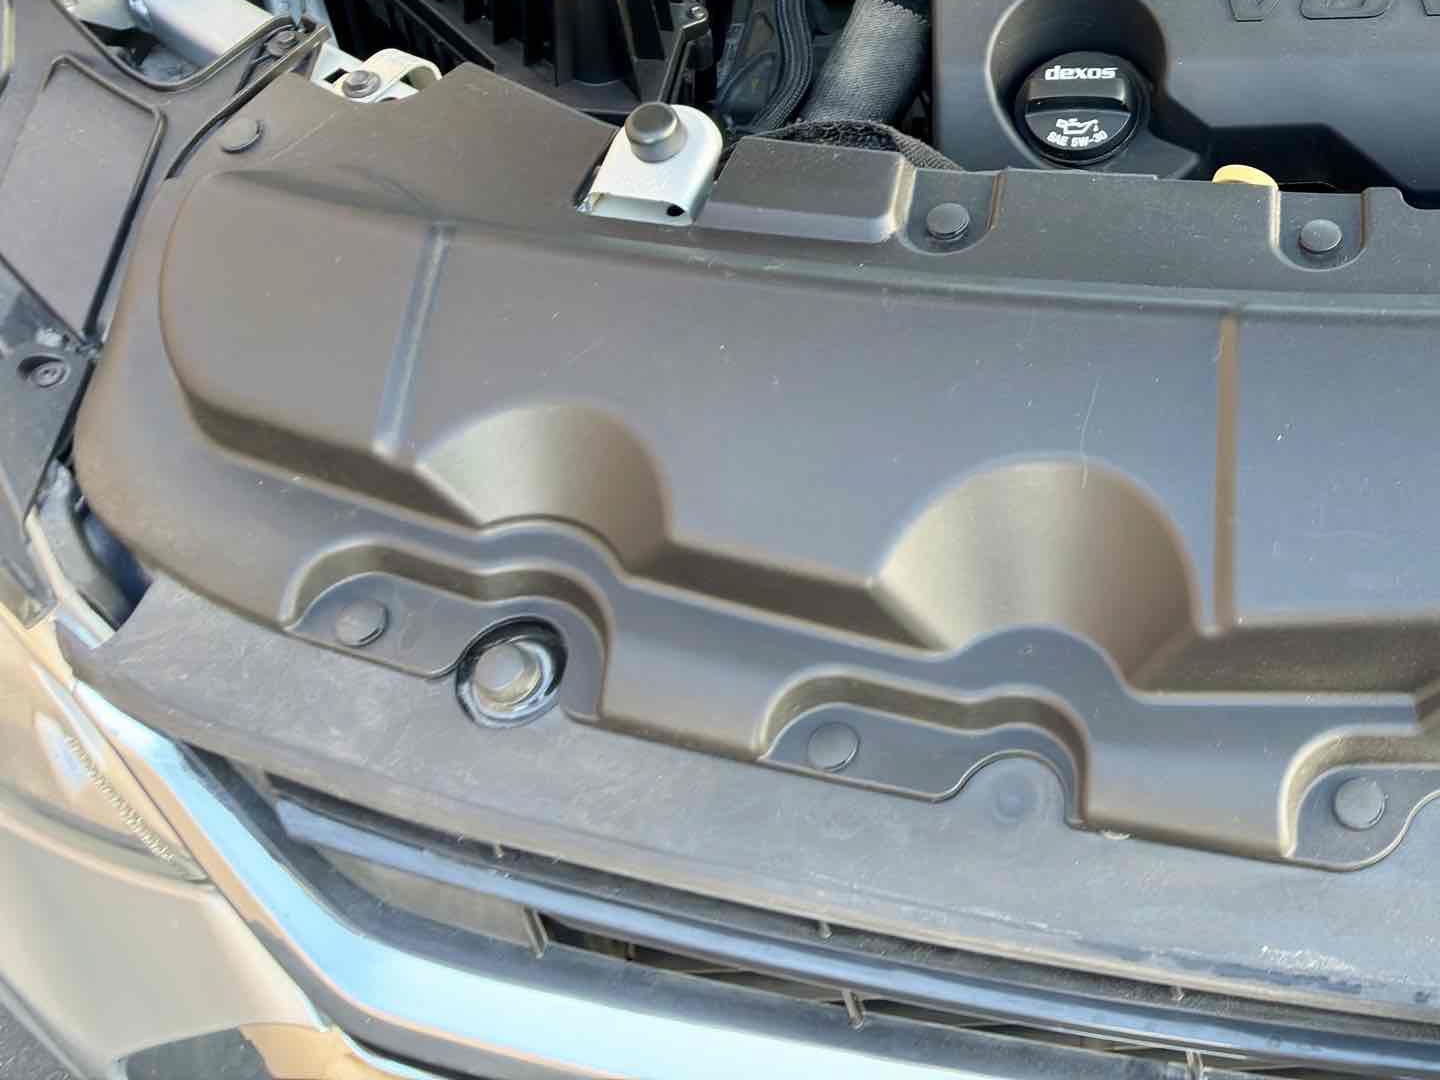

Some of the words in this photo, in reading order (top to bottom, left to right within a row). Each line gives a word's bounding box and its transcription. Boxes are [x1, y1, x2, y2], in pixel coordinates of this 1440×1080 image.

[1044, 65, 1119, 80] dexos
[1047, 131, 1069, 147] SAE
[1071, 129, 1108, 148] 5W-30
